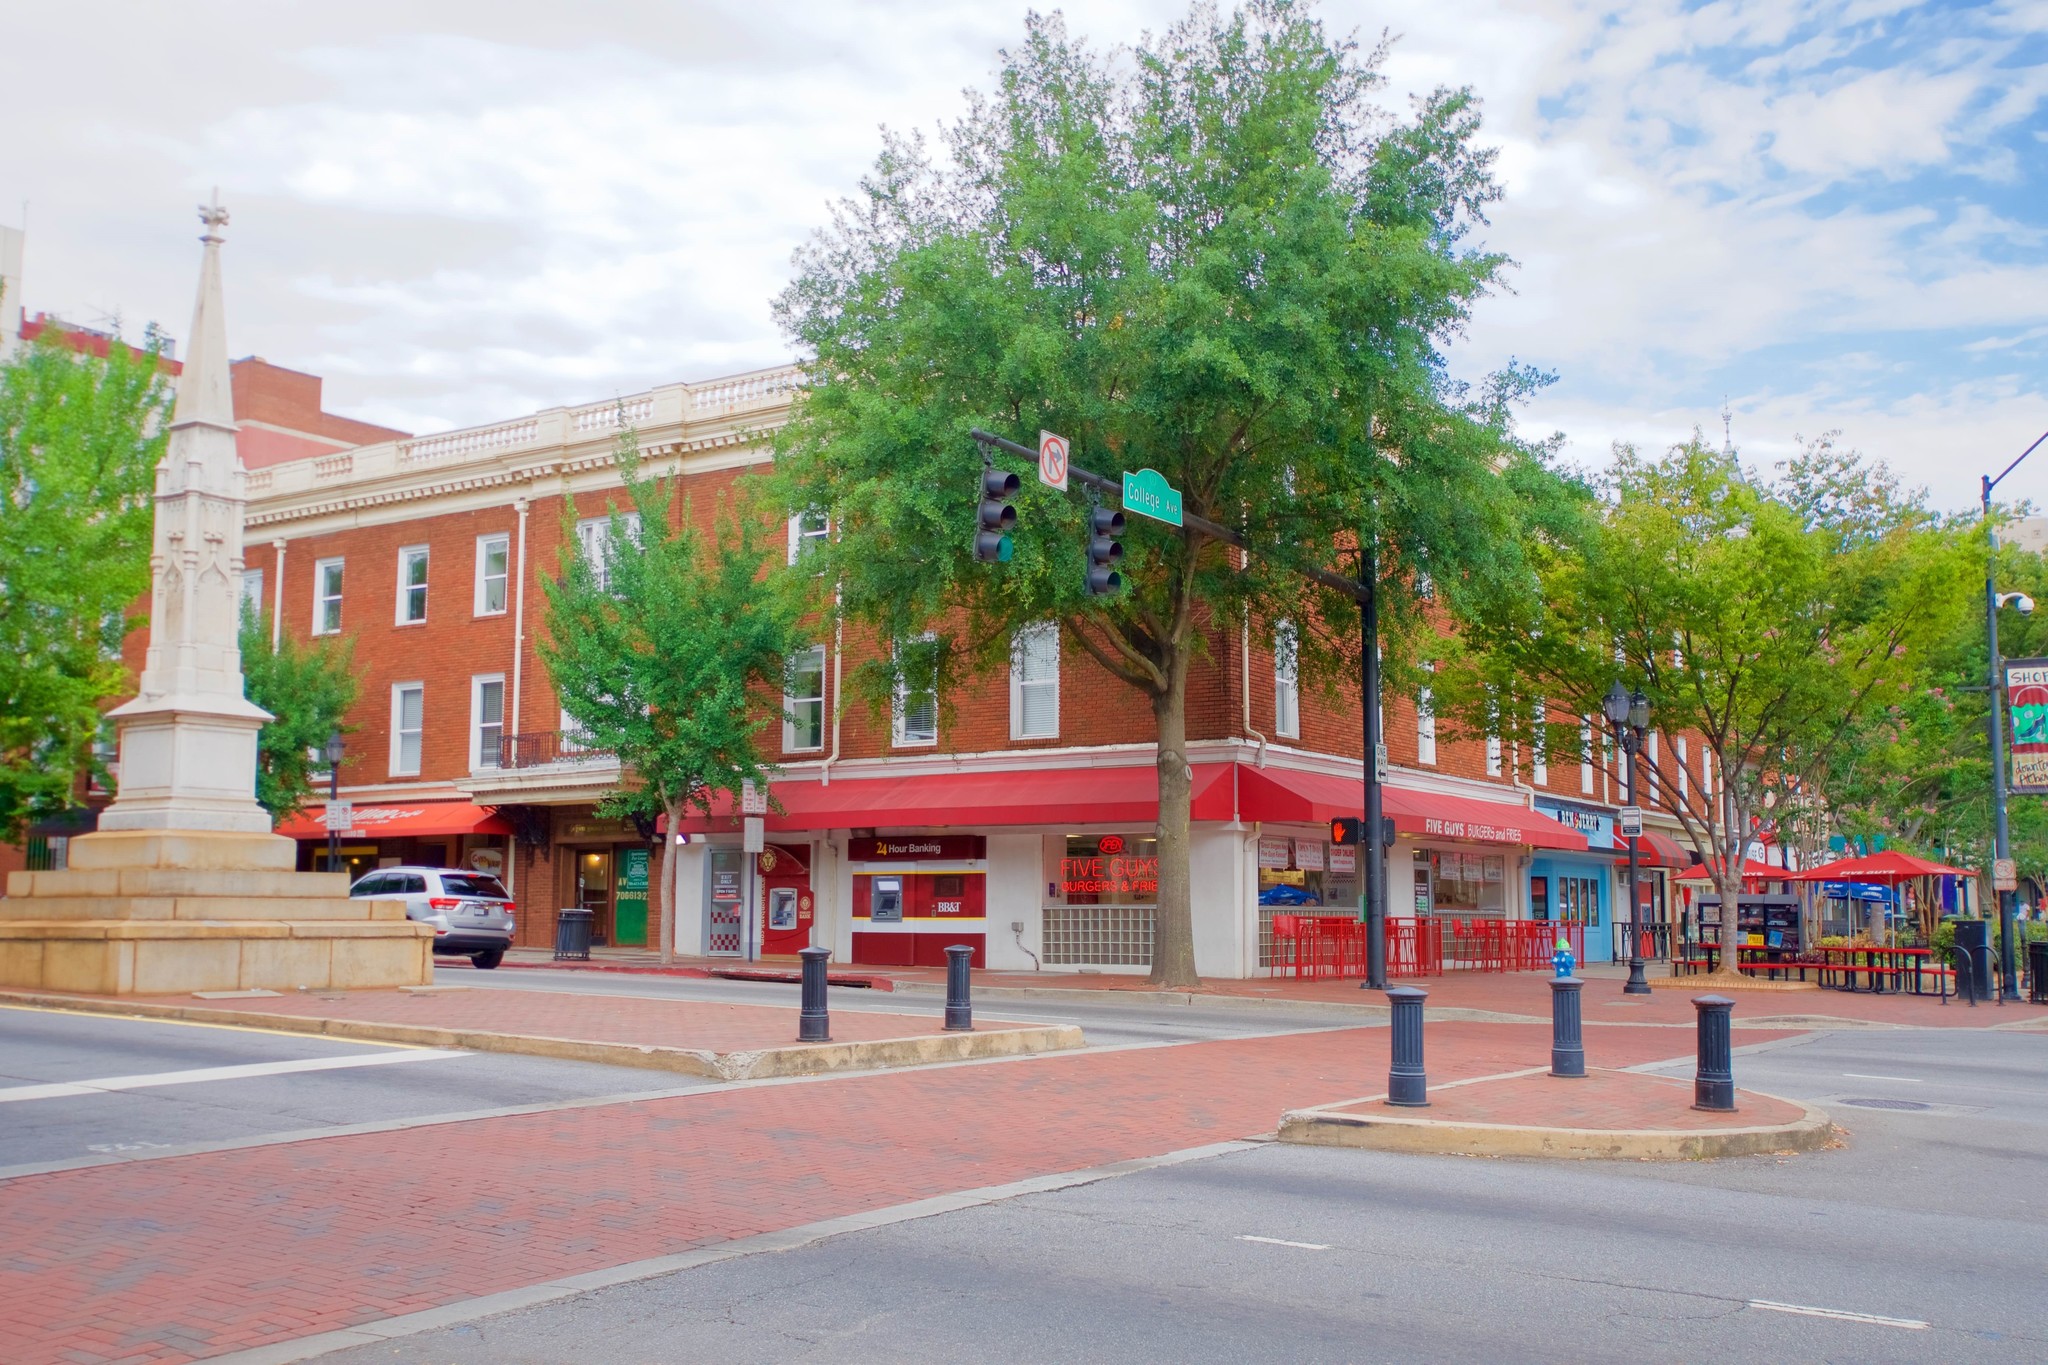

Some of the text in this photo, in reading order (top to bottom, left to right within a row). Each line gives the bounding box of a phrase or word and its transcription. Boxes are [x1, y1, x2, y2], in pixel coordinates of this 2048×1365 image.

[1128, 482, 1178, 515] College Ave
[1377, 746, 1386, 757] ONE
[1377, 757, 1387, 768] WAY
[2016, 758, 2048, 774] downto
[1426, 819, 1521, 842] FIVE GUYS BURGERS and FRIES
[877, 842, 941, 855] 24 Hour Banking
[1061, 858, 1104, 877] FIVE
[1062, 881, 1118, 893] BURGERS
[1121, 880, 1130, 893] &
[938, 902, 961, 912] BB&T
